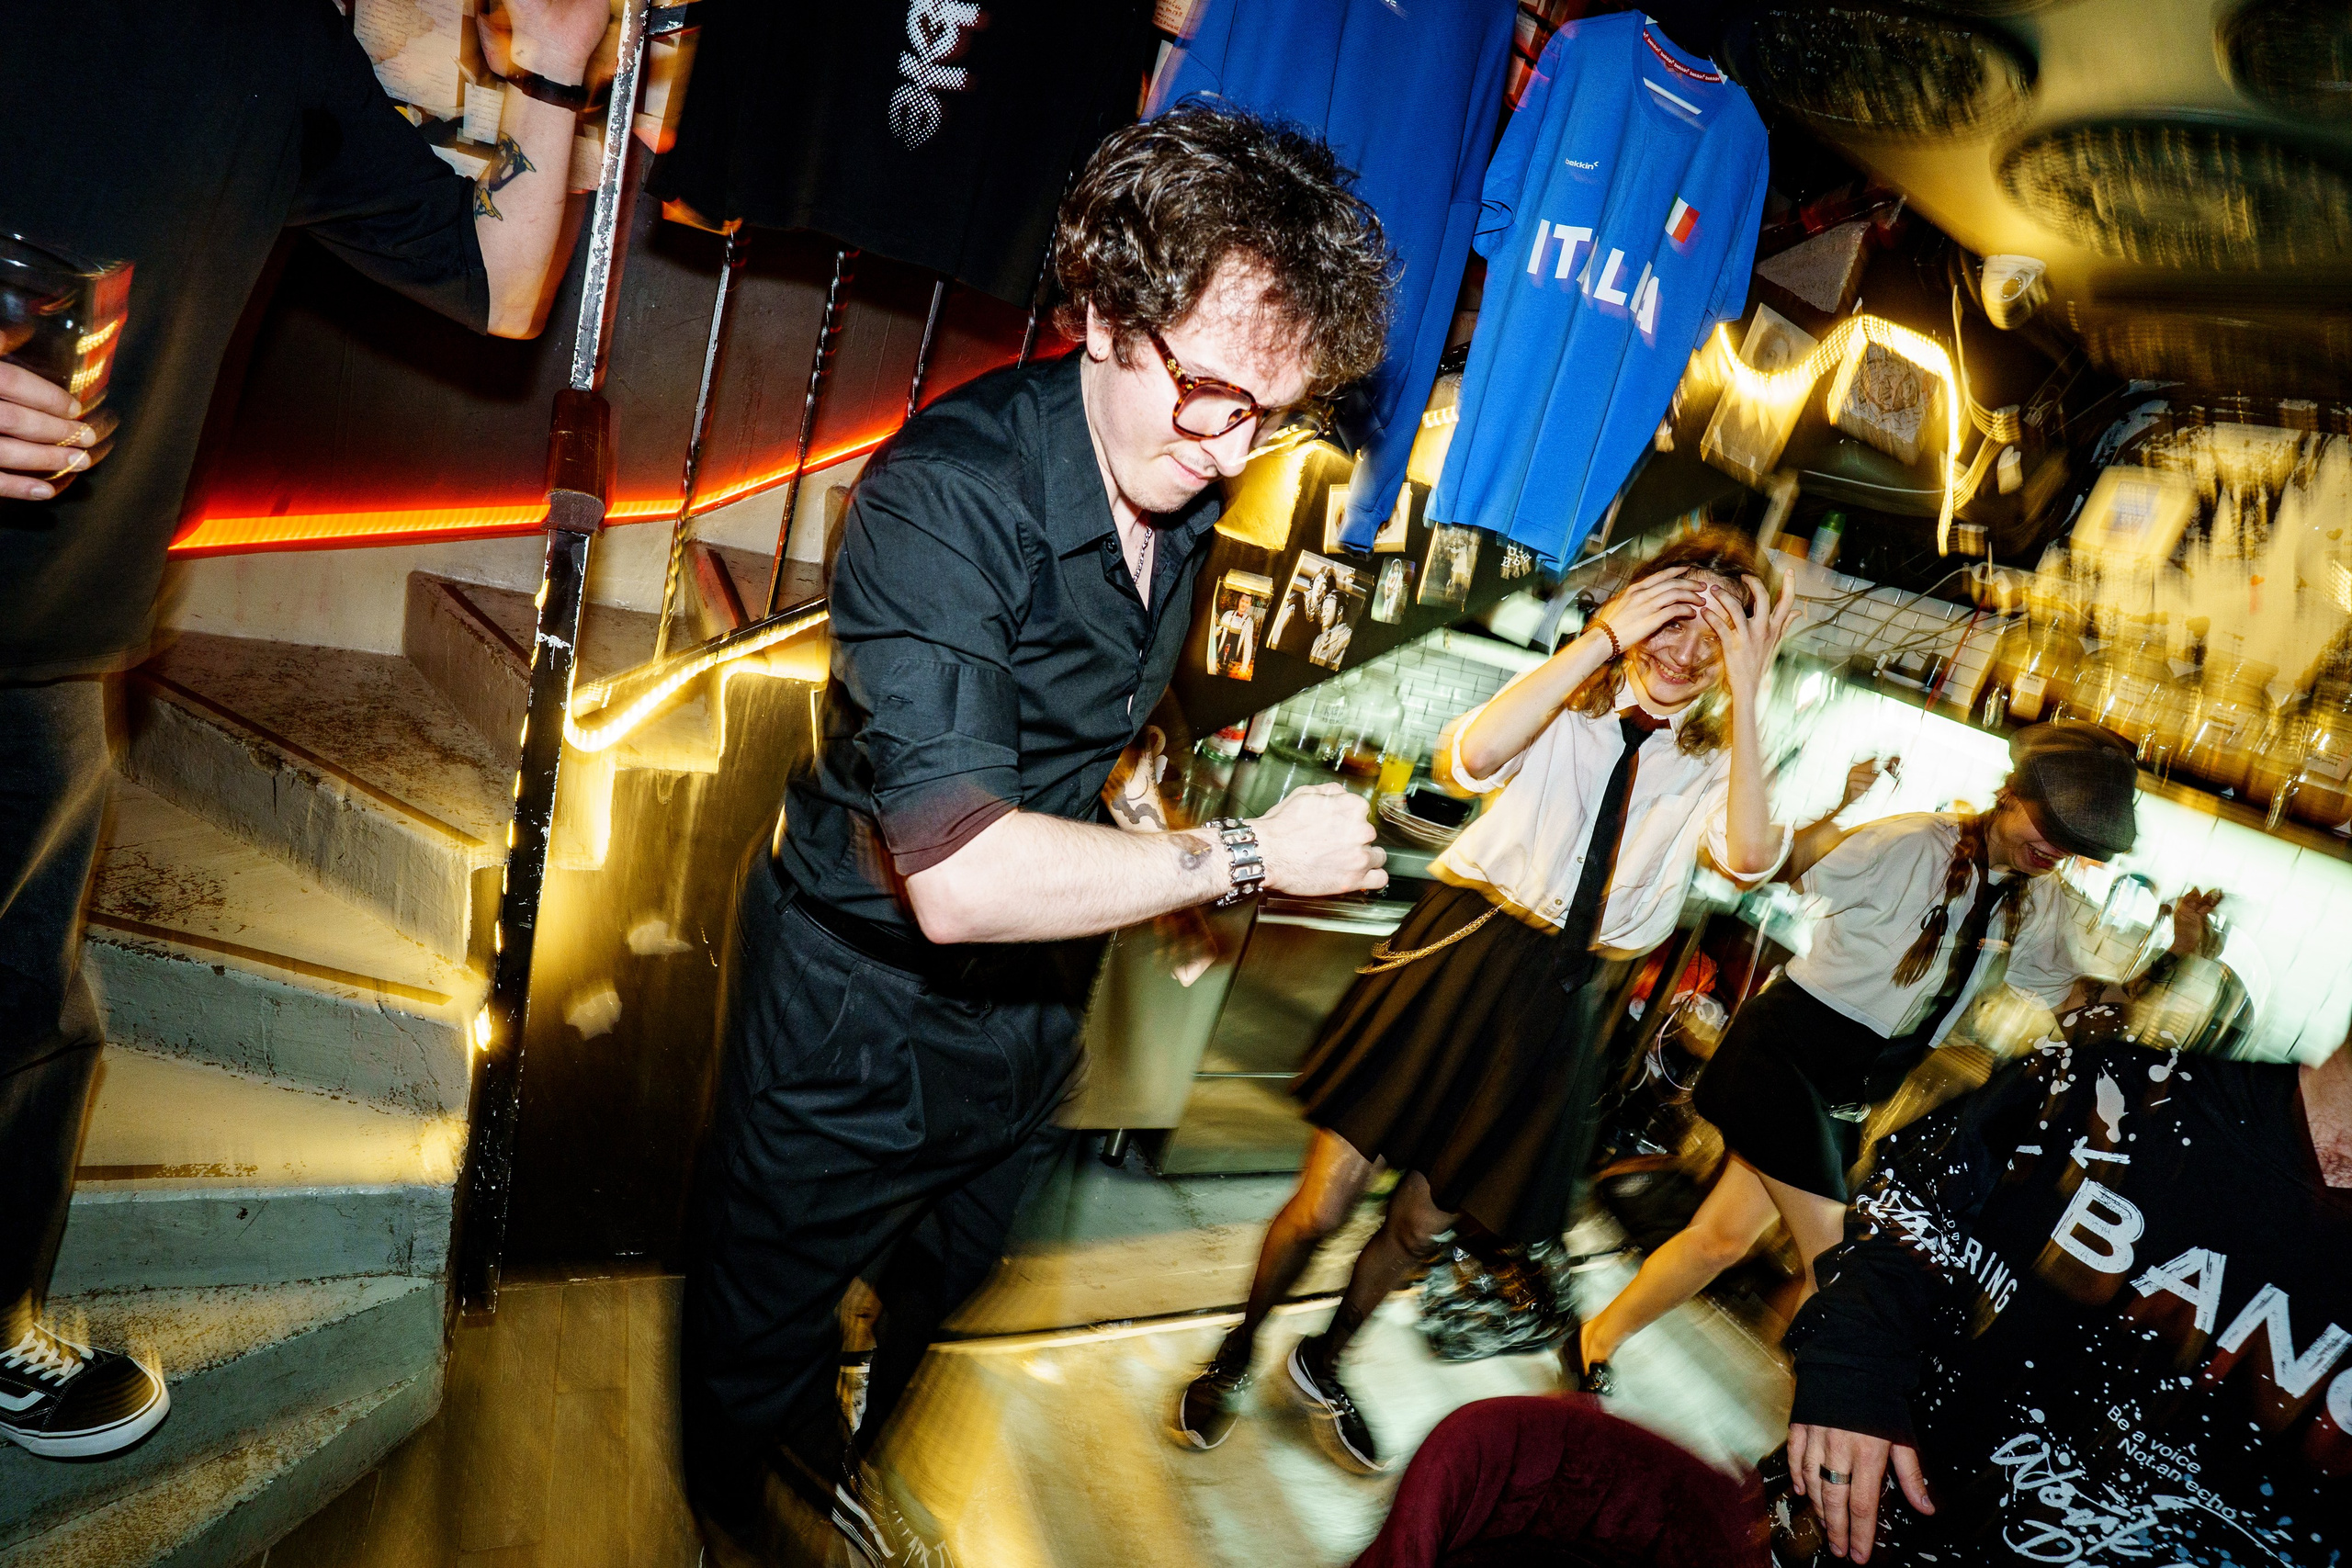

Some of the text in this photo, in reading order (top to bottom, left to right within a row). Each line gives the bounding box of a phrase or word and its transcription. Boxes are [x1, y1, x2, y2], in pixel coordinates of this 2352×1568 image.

[1565, 157, 1594, 170] bekkin
[2051, 1176, 2352, 1437] BAN
[2107, 1405, 2201, 1473] Be a voice
[2155, 1463, 2183, 1482] an
[2185, 1480, 2236, 1519] echo
